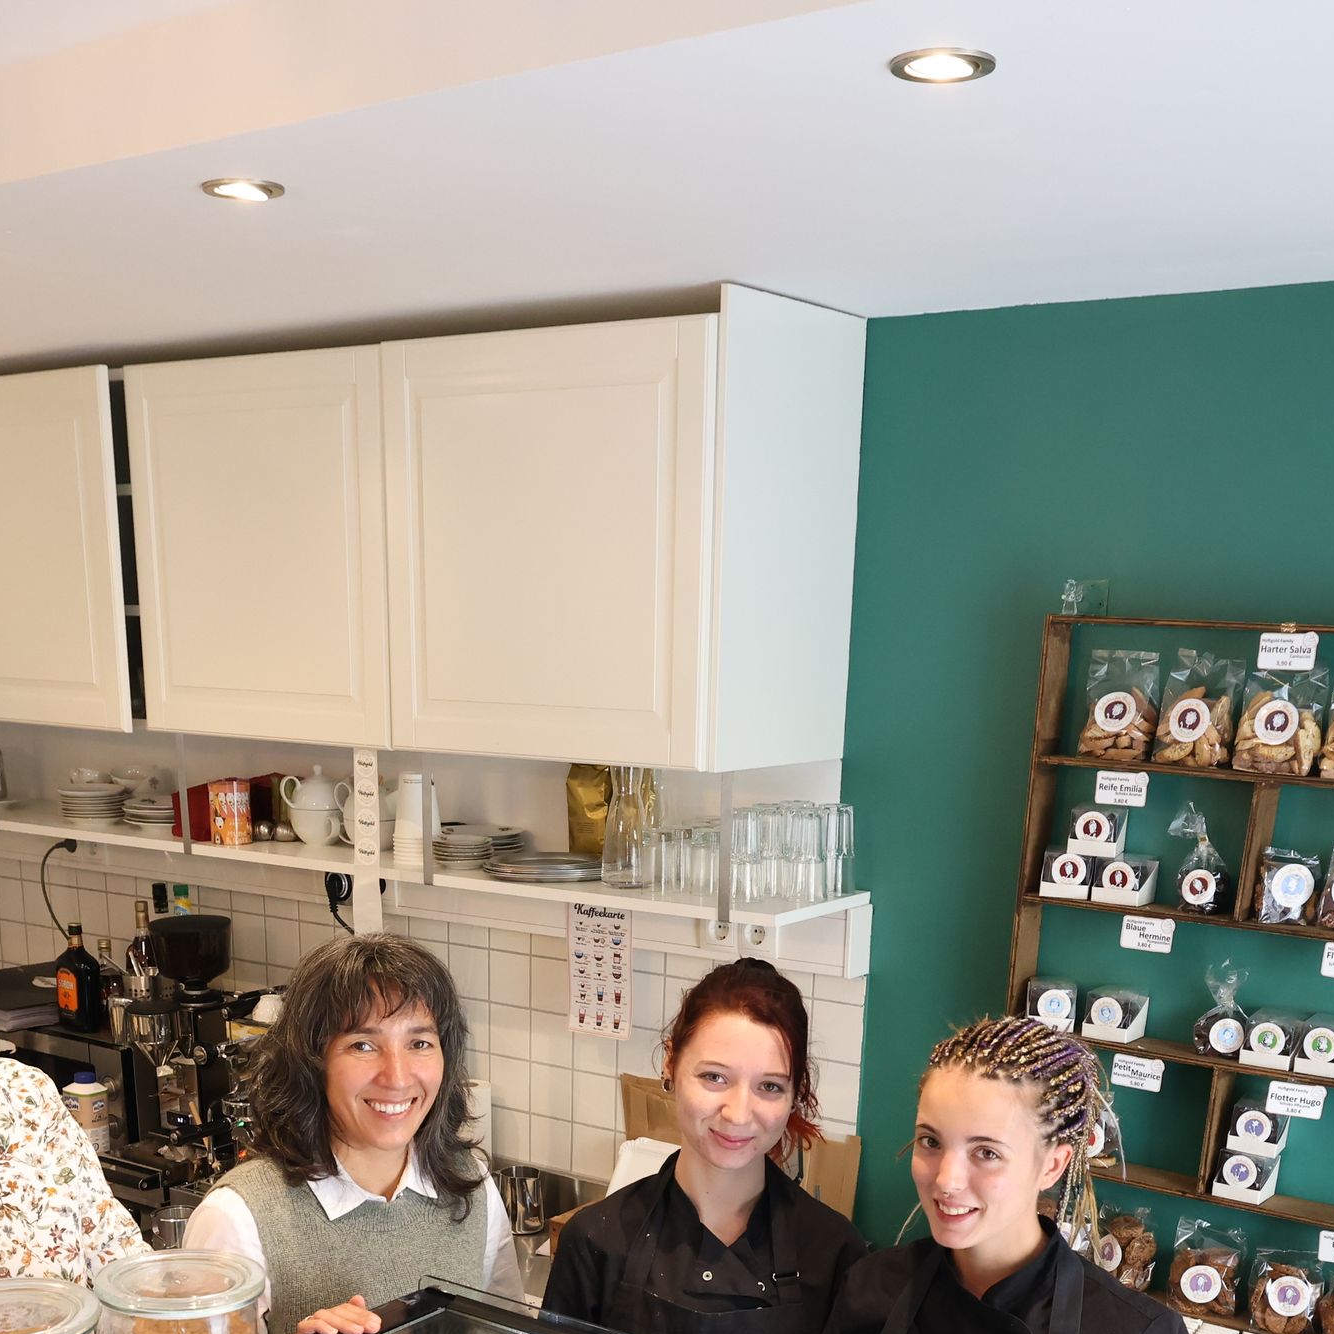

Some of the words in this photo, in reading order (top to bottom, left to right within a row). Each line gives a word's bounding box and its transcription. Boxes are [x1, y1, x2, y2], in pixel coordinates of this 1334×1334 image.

[1261, 645, 1287, 654] Harter
[1289, 645, 1311, 654] Salva
[1099, 783, 1117, 791] Reife
[1119, 784, 1143, 792] Emilia
[574, 903, 625, 920] Kaffeekarte
[1125, 922, 1147, 932] Blaue
[1139, 932, 1171, 942] Hermine
[1114, 1062, 1131, 1071] Petit
[1131, 1069, 1161, 1081] Maurice
[1270, 1092, 1298, 1102] Flotter
[1300, 1098, 1321, 1107] Hugo
